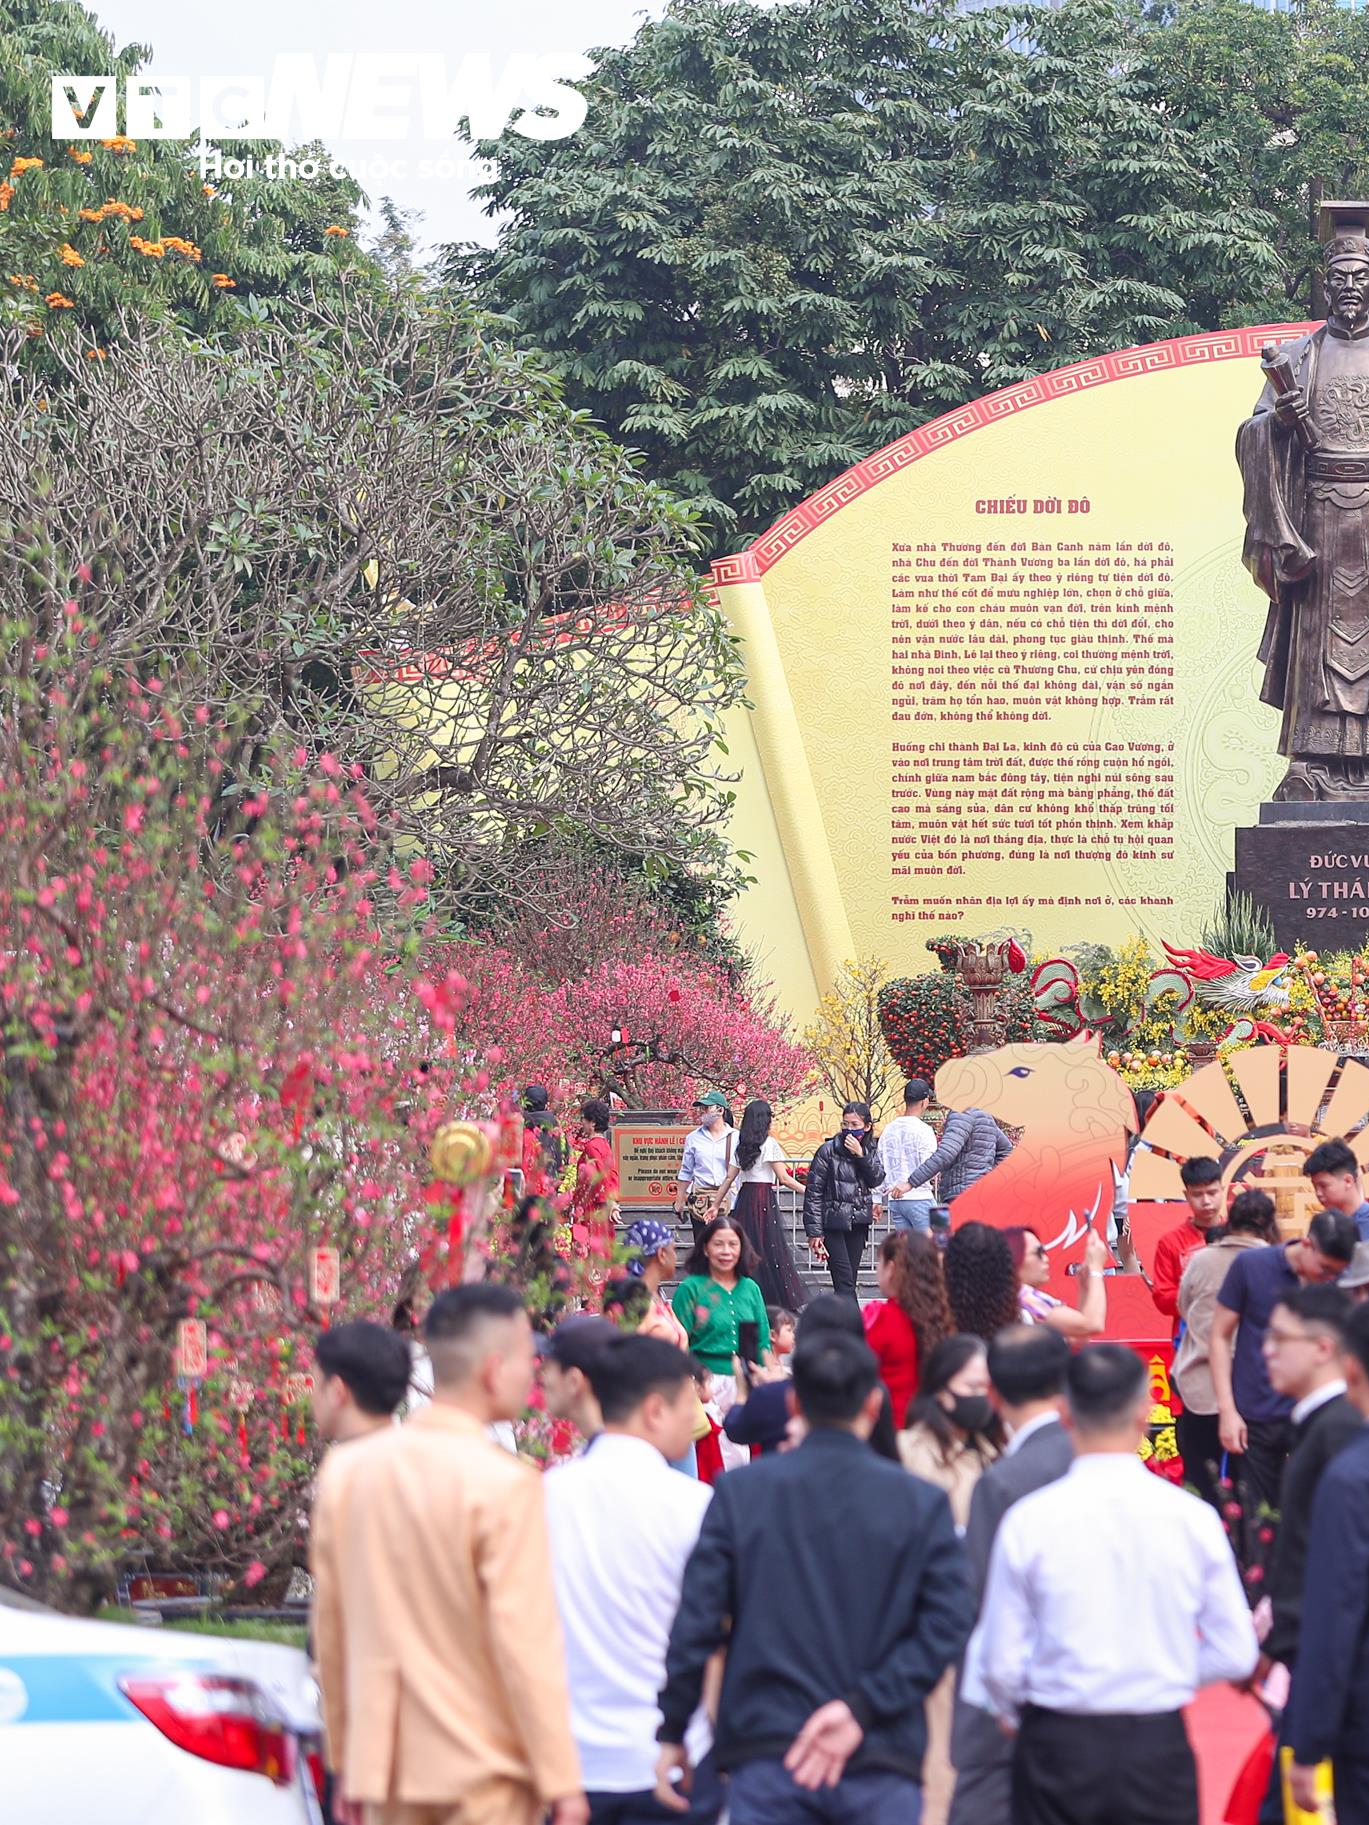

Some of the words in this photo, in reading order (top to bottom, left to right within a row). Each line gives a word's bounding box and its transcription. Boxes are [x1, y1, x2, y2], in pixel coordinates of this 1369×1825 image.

[975, 494, 1028, 514] CHIẾU
[1033, 496, 1062, 514] DỜI
[1067, 496, 1091, 514] ĐÔ
[892, 543, 911, 552] Xưa
[941, 543, 981, 553] Thương
[1057, 542, 1083, 551] Canh
[916, 558, 935, 567] Chu
[1021, 558, 1053, 568] Vương
[962, 573, 986, 582] Tam
[1029, 573, 1051, 582] theo
[918, 589, 939, 598] như
[997, 589, 1020, 597] mưu
[933, 604, 951, 613] cho
[943, 619, 965, 628] theo
[1155, 619, 1174, 628] cho
[1013, 634, 1045, 646] phong
[892, 650, 908, 659] hai
[996, 650, 1018, 659] theo
[1064, 650, 1078, 659] coi
[928, 665, 944, 674] noi
[947, 665, 969, 674] theo
[1014, 665, 1054, 676] Thương
[909, 681, 925, 690] nơi
[892, 712, 911, 720] đau
[929, 742, 945, 751] chi
[1024, 742, 1046, 751] kinh
[1105, 742, 1124, 751] Cao
[913, 758, 929, 767] nơi
[932, 758, 960, 769] trung
[1078, 772, 1101, 785] nghi
[1155, 775, 1174, 783] sau
[892, 806, 910, 814] cao
[1015, 819, 1034, 828] tươi
[1121, 818, 1144, 829] Xem
[974, 835, 990, 844] nơi
[1148, 836, 1173, 847] quan
[1054, 850, 1070, 859] nơi
[1133, 850, 1156, 860] kinh
[1309, 850, 1348, 869] ĐỨC
[1289, 877, 1313, 899] LÝ
[1085, 896, 1101, 905] nơi
[1141, 895, 1173, 905] khanh
[1306, 906, 1338, 919] 974
